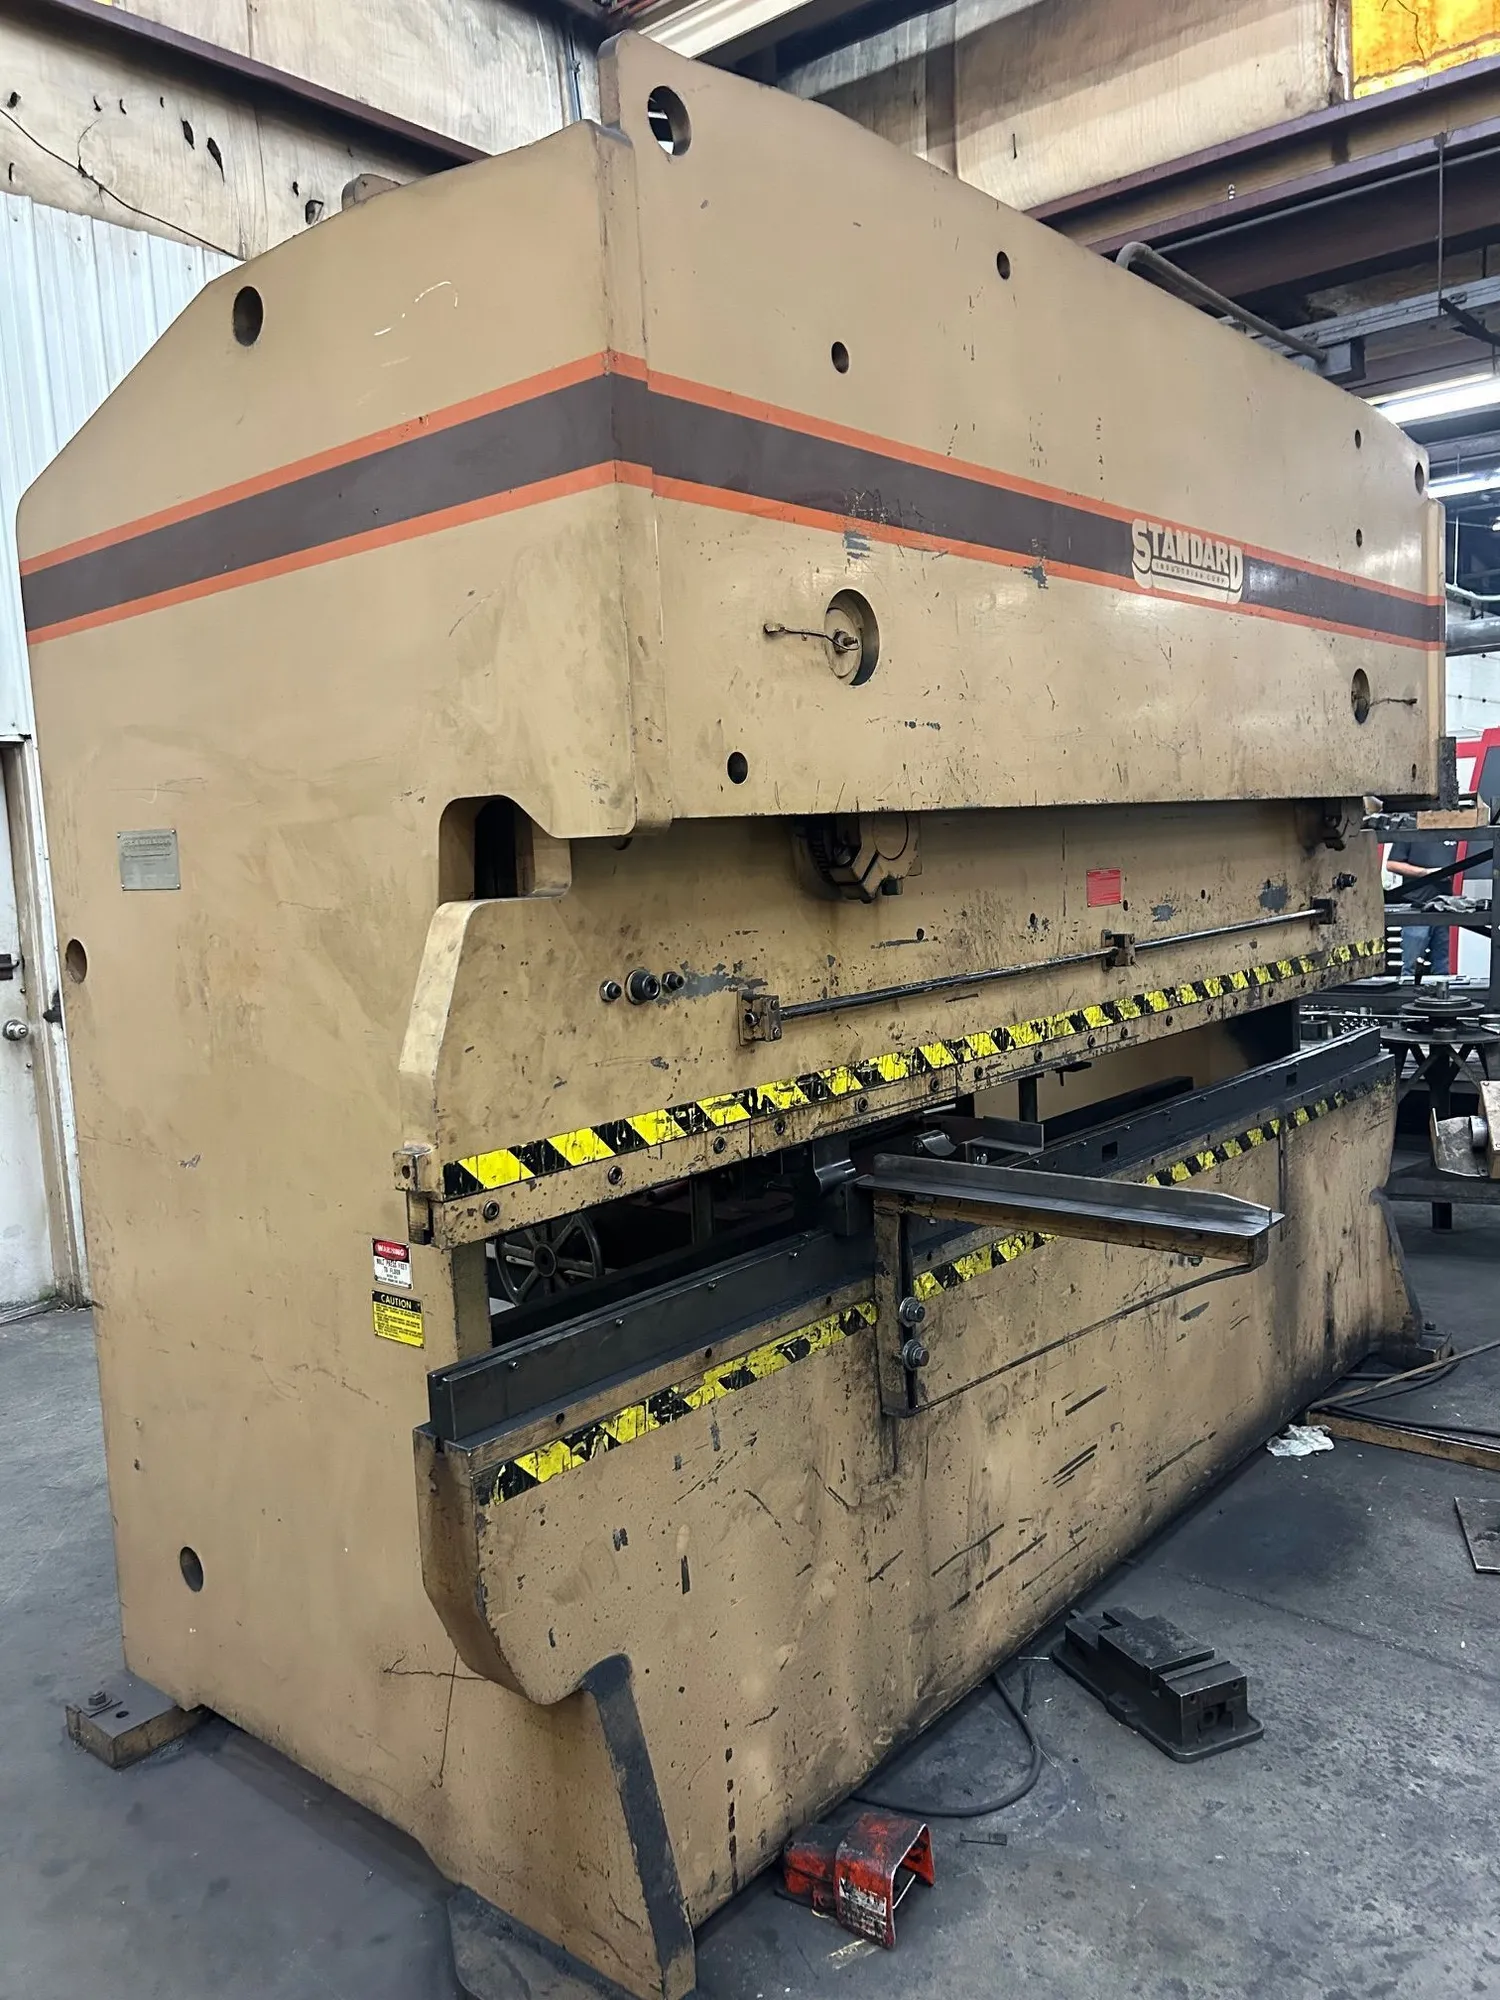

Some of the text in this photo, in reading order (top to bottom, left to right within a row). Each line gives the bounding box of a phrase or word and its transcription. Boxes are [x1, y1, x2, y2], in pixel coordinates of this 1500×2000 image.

[1132, 519, 1243, 592] STANDARD
[378, 1244, 405, 1256] WARNING
[381, 1294, 412, 1309] CAUTION
